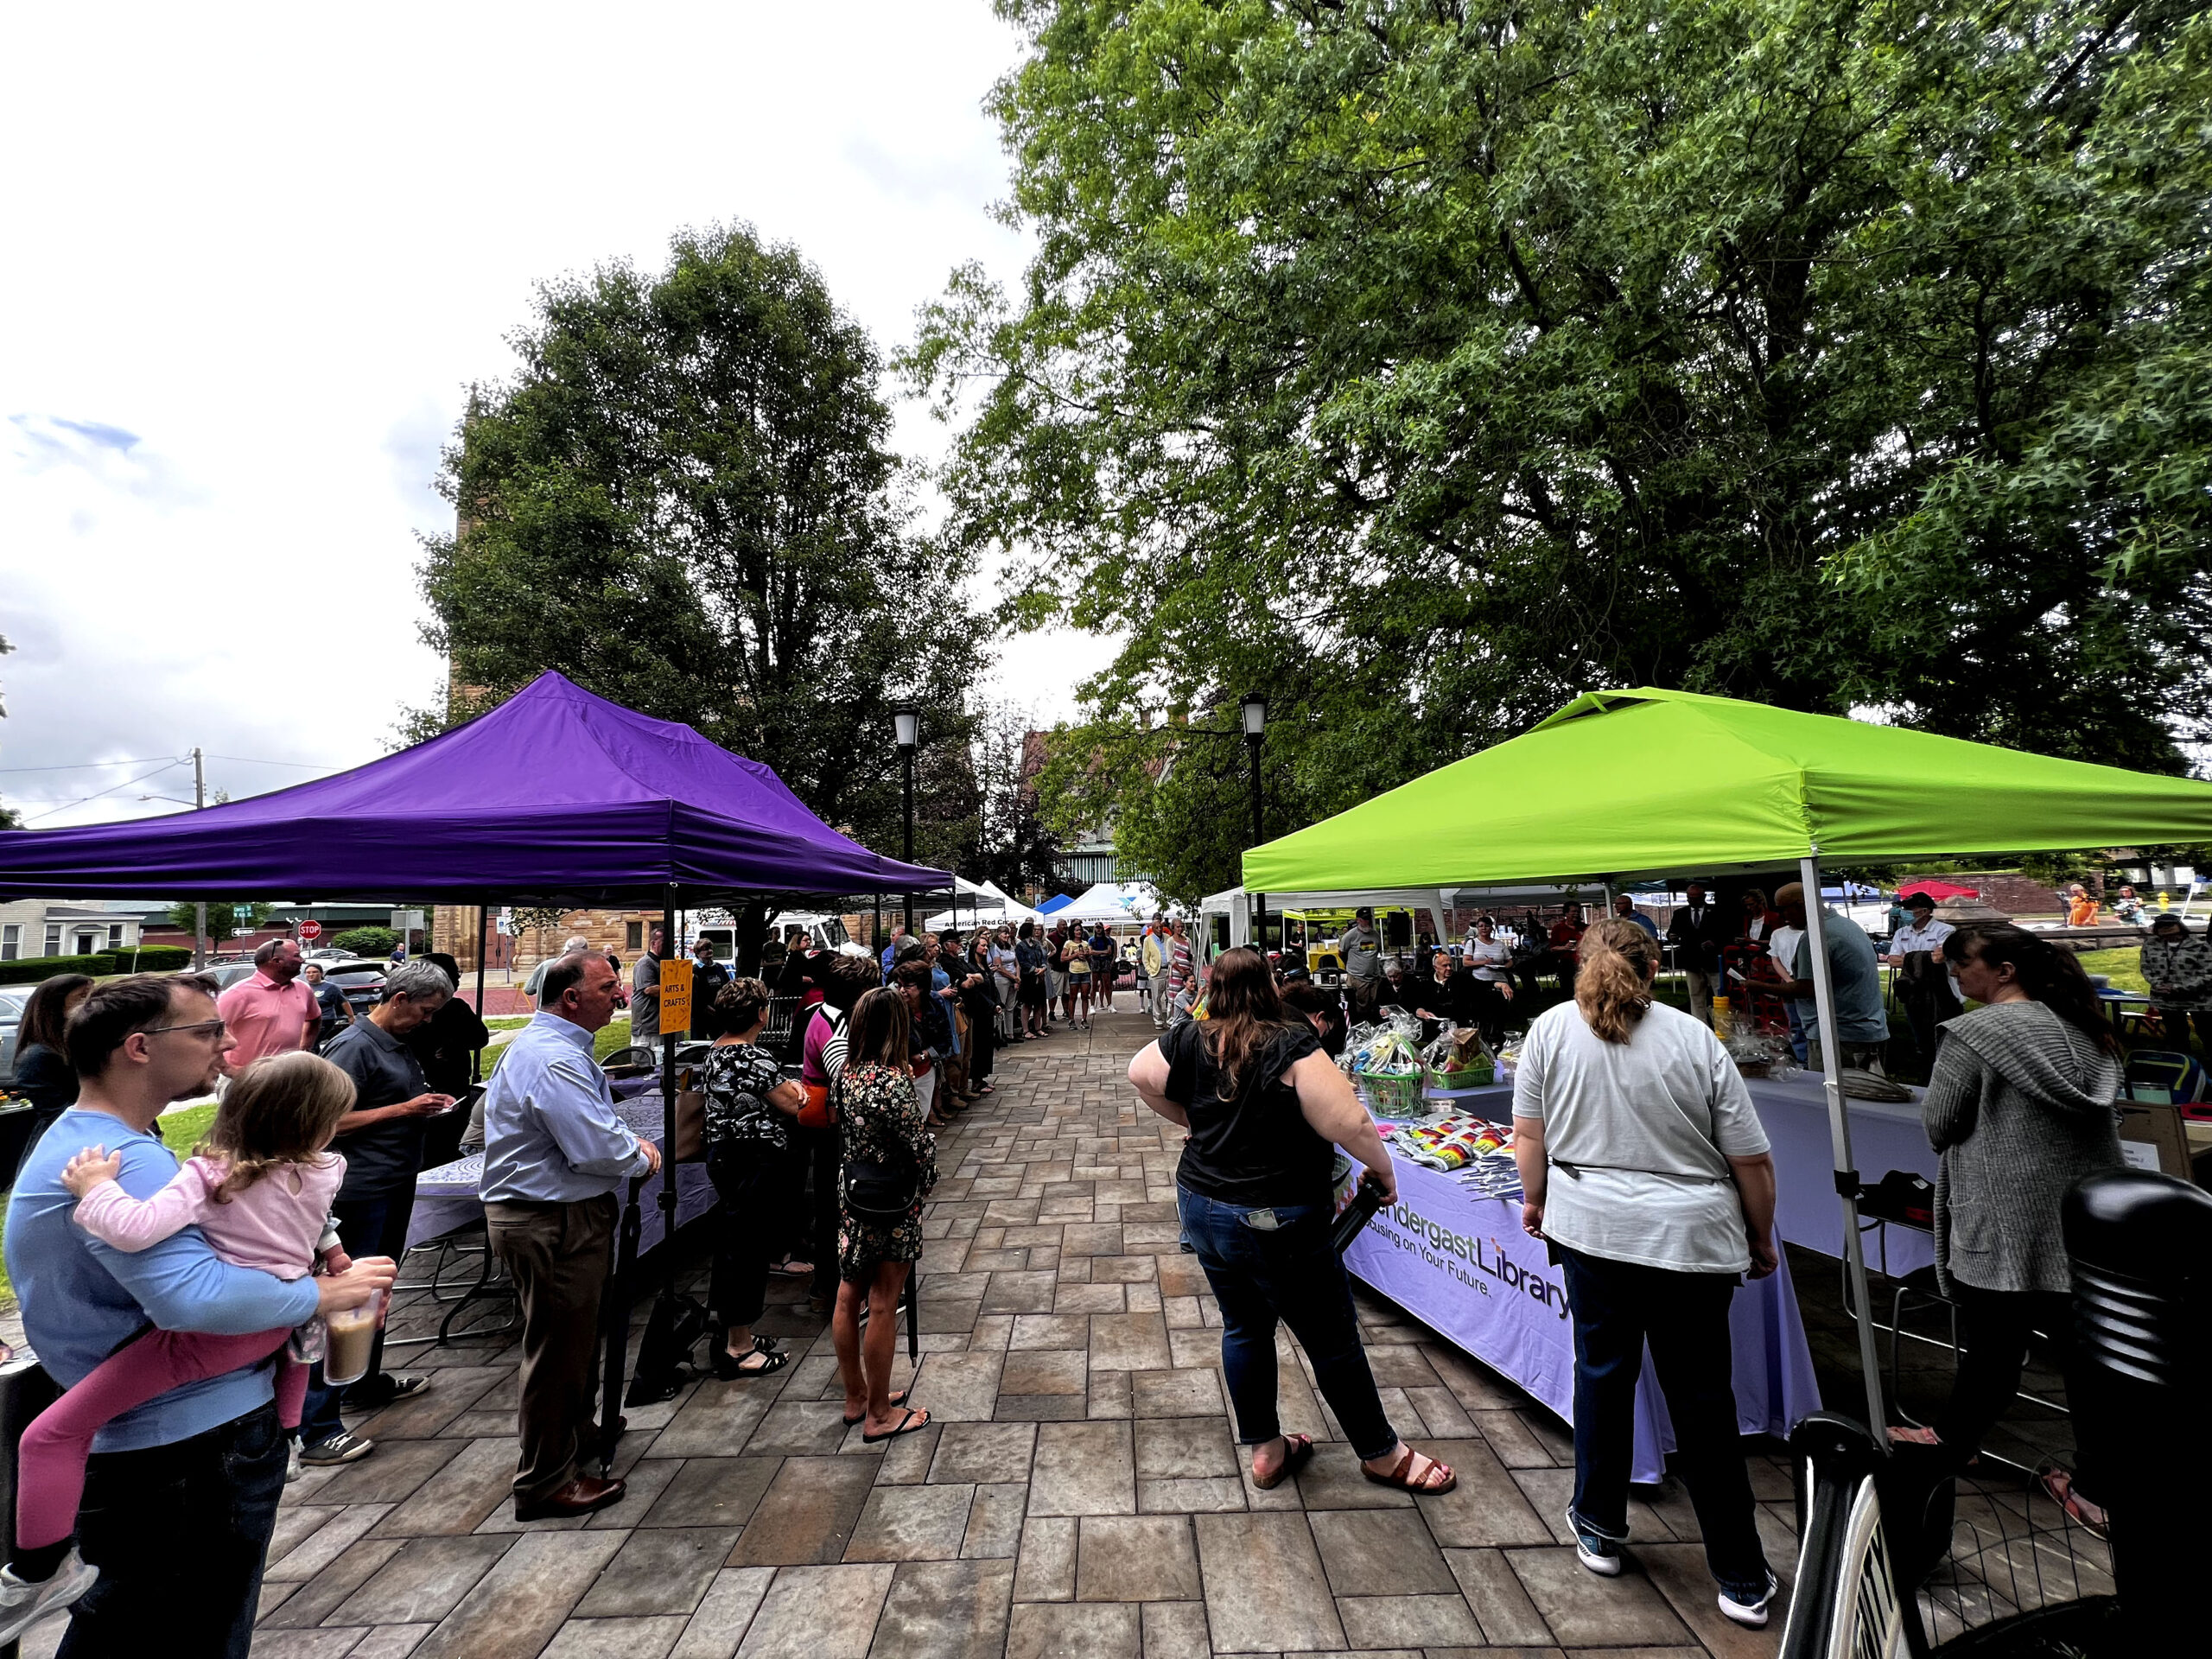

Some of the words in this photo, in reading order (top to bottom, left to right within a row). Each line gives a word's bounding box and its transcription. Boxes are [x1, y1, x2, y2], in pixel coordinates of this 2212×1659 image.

[300, 925, 320, 934] STOP
[664, 984, 679, 993] ARTS
[680, 983, 685, 992] &
[664, 997, 686, 1007] CRAFTS
[1402, 1238, 1417, 1255] on
[1419, 1243, 1445, 1272] Your
[1447, 1259, 1492, 1299] Future.
